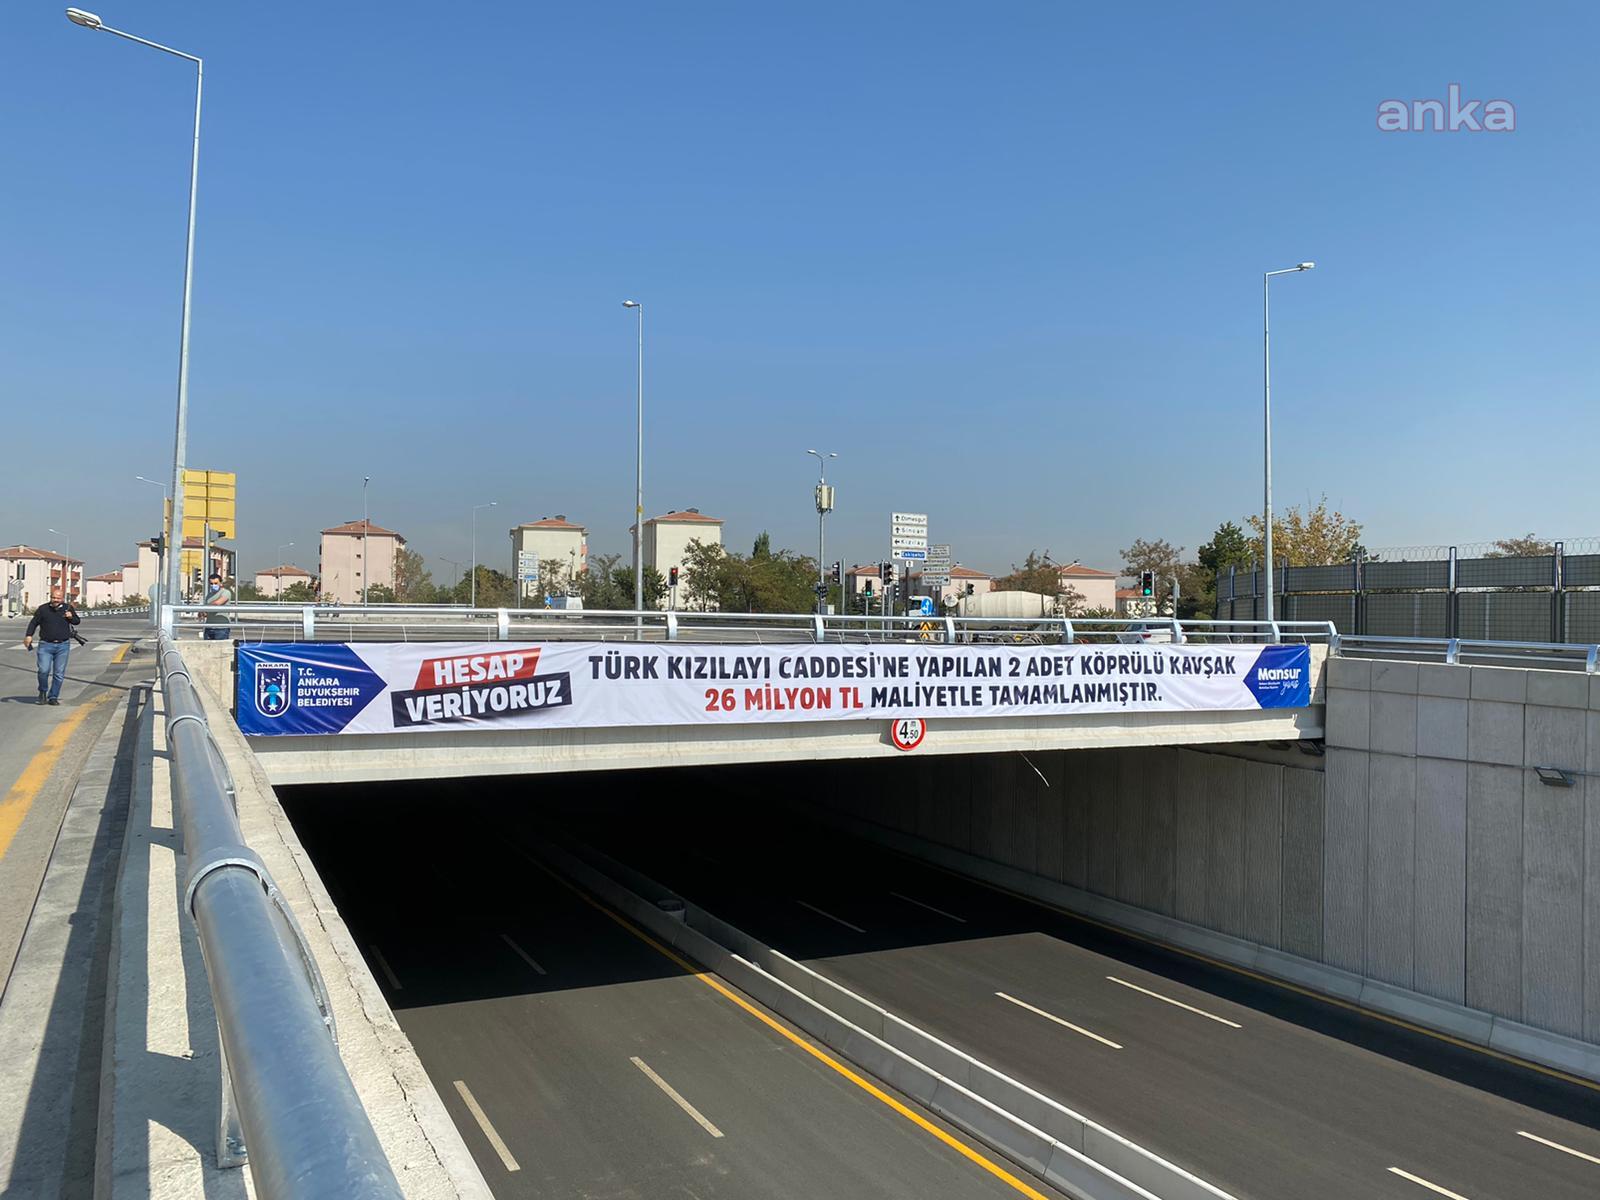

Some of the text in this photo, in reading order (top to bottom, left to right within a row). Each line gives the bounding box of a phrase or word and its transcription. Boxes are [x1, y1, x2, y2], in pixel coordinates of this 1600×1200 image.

[297, 667, 316, 676] T.C.
[433, 653, 524, 686] HESAP
[588, 650, 1236, 680] TÜRK KIZILAYI CADDESİ'NE YAPILAN 2 ADET KÖPRÜLÜ KAVŞAK
[1258, 667, 1302, 681] Mansur
[297, 678, 340, 686] ANKARA
[705, 681, 1163, 712] 26 MİLYON TL MALİYETLE TAMAMLANMIŞTIR.
[404, 679, 563, 722] VERİYORUZ
